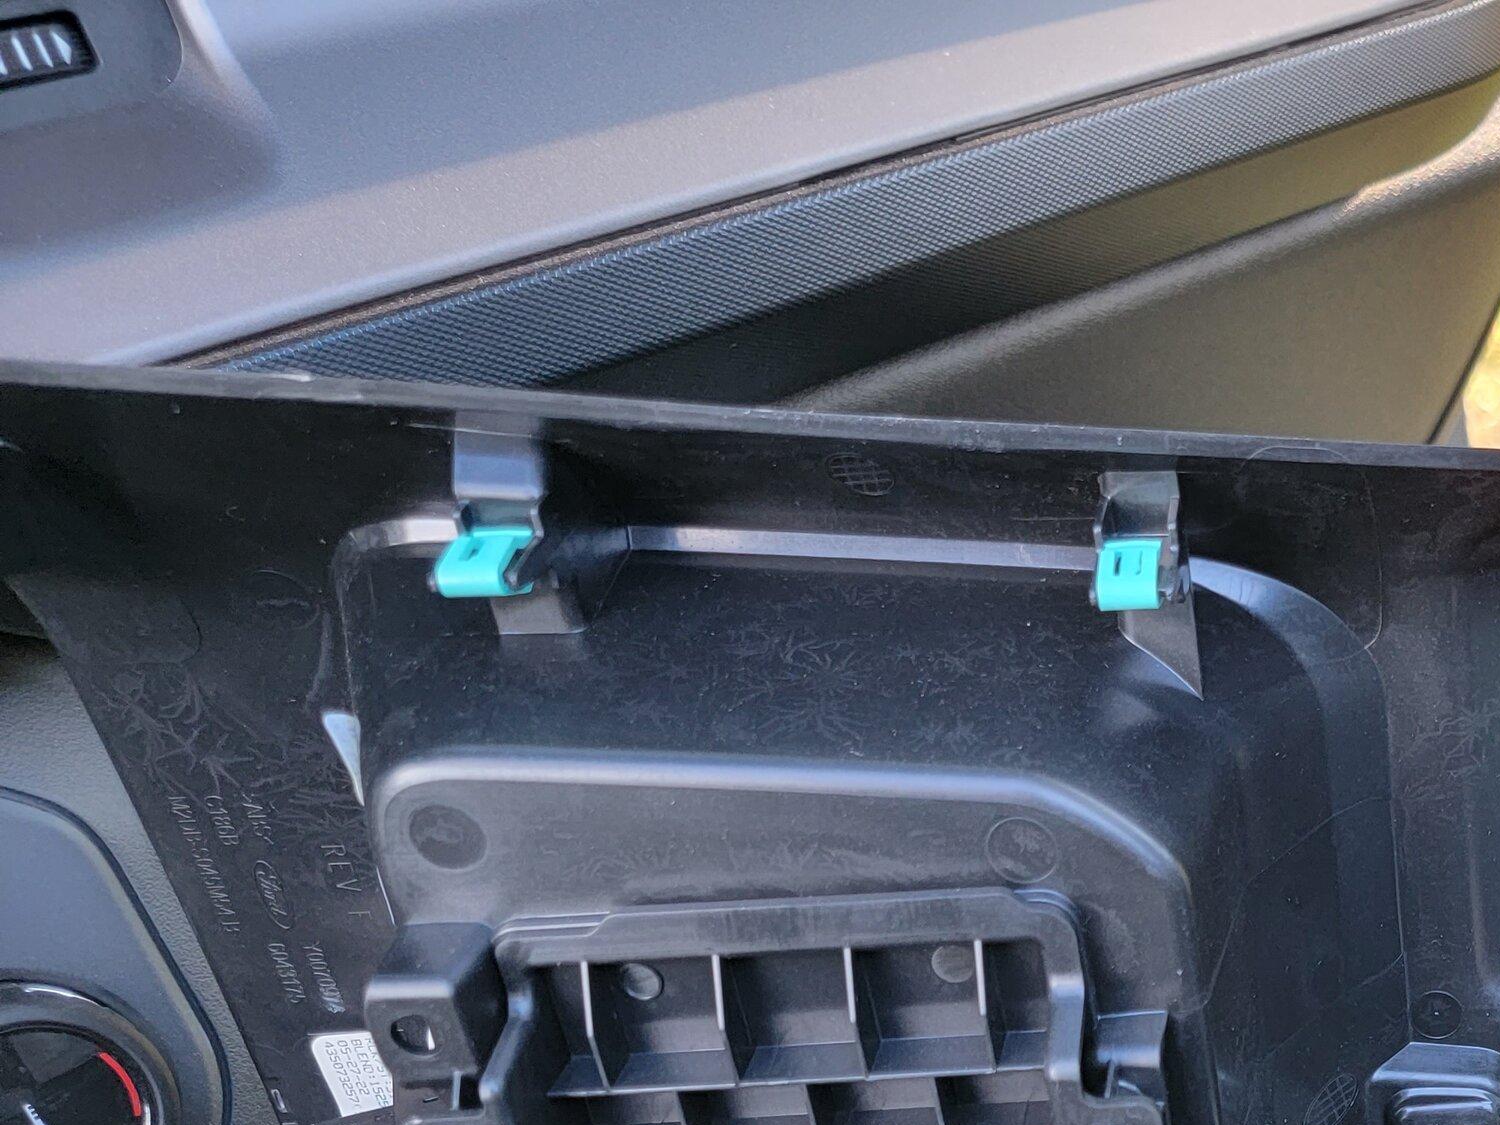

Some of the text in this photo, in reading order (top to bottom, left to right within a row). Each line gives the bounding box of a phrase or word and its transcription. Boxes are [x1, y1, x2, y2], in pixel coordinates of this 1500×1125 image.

[255, 866, 289, 920] Ford
[320, 844, 373, 920] REV F
[336, 1039, 371, 1096] 05-27-22
